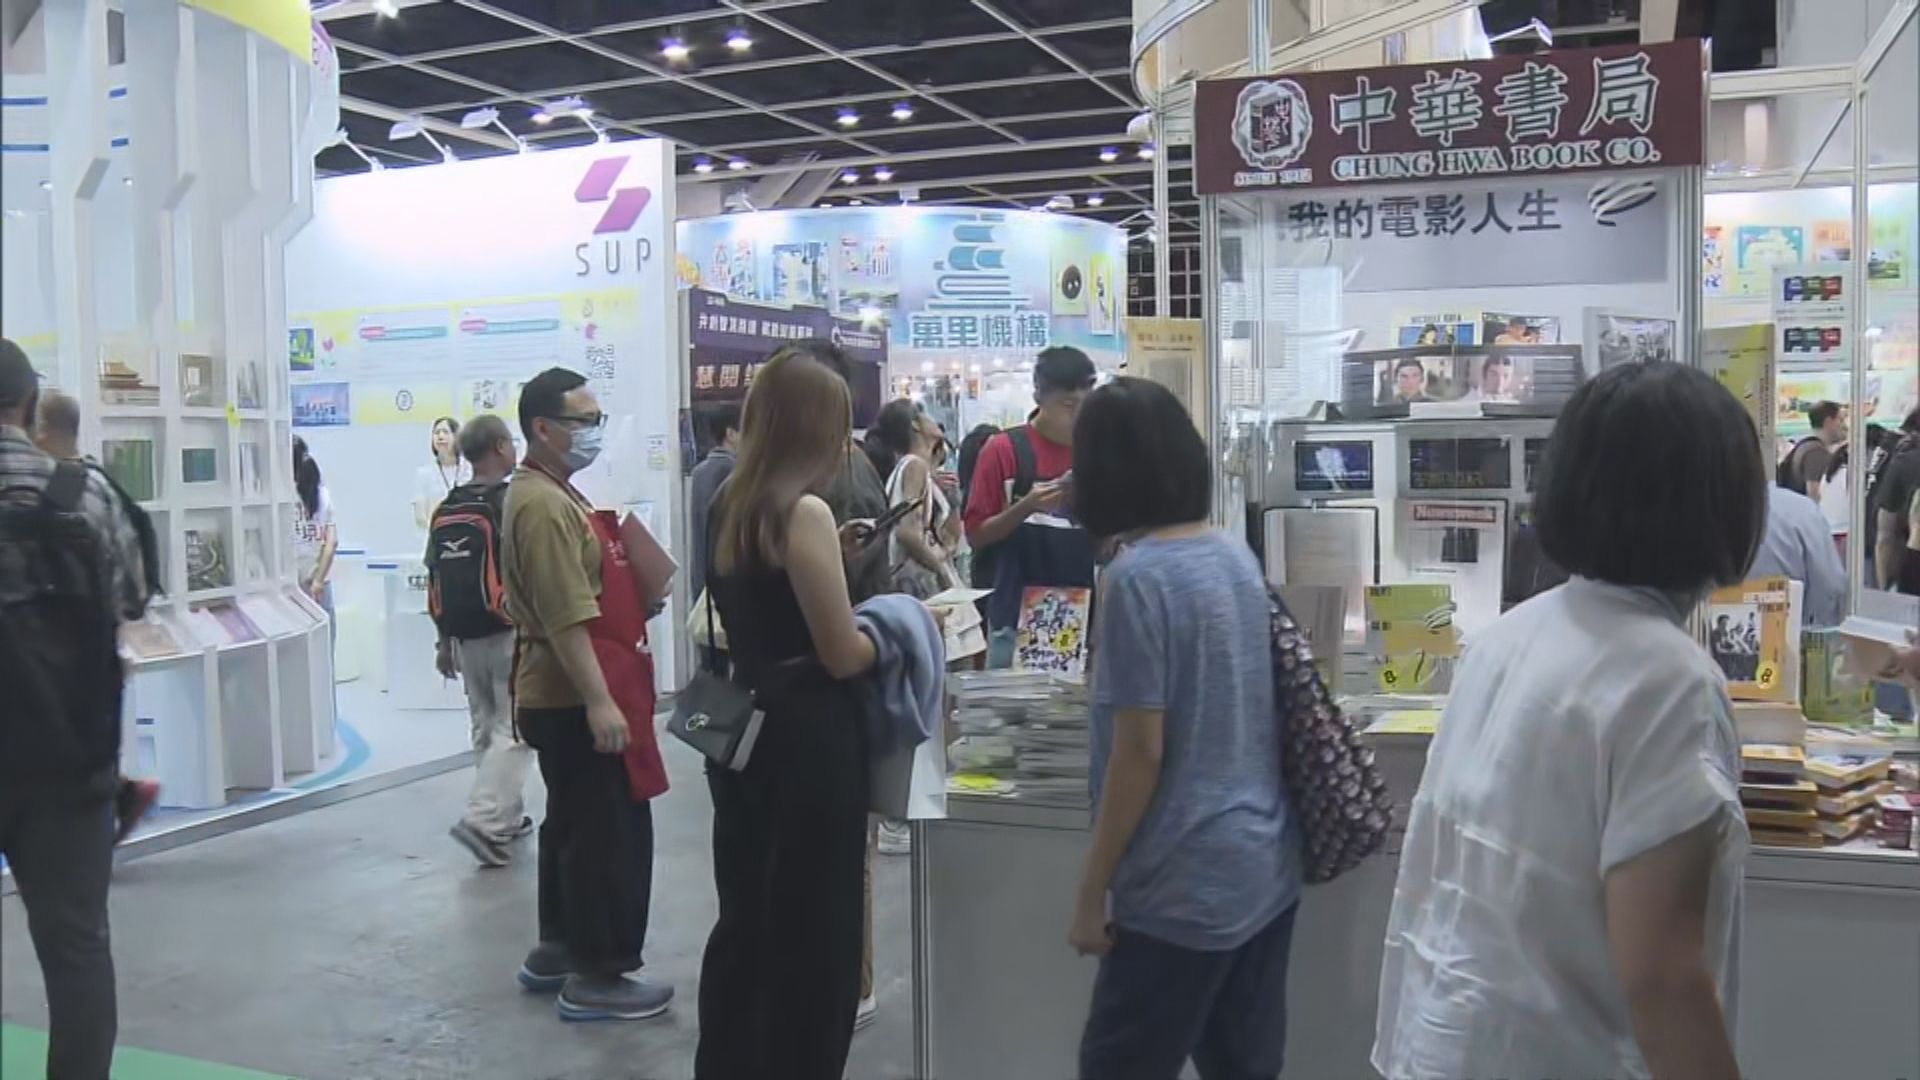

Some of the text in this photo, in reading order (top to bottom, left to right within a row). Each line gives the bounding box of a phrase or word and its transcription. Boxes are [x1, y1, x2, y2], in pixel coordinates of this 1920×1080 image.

[1330, 53, 1660, 153] 中華書局
[1332, 137, 1661, 181] CHUNG HWA BOOK CO.
[1288, 188, 1561, 242] 我的電影人生
[575, 238, 651, 276] SUP
[911, 314, 1048, 348] 萬里機構
